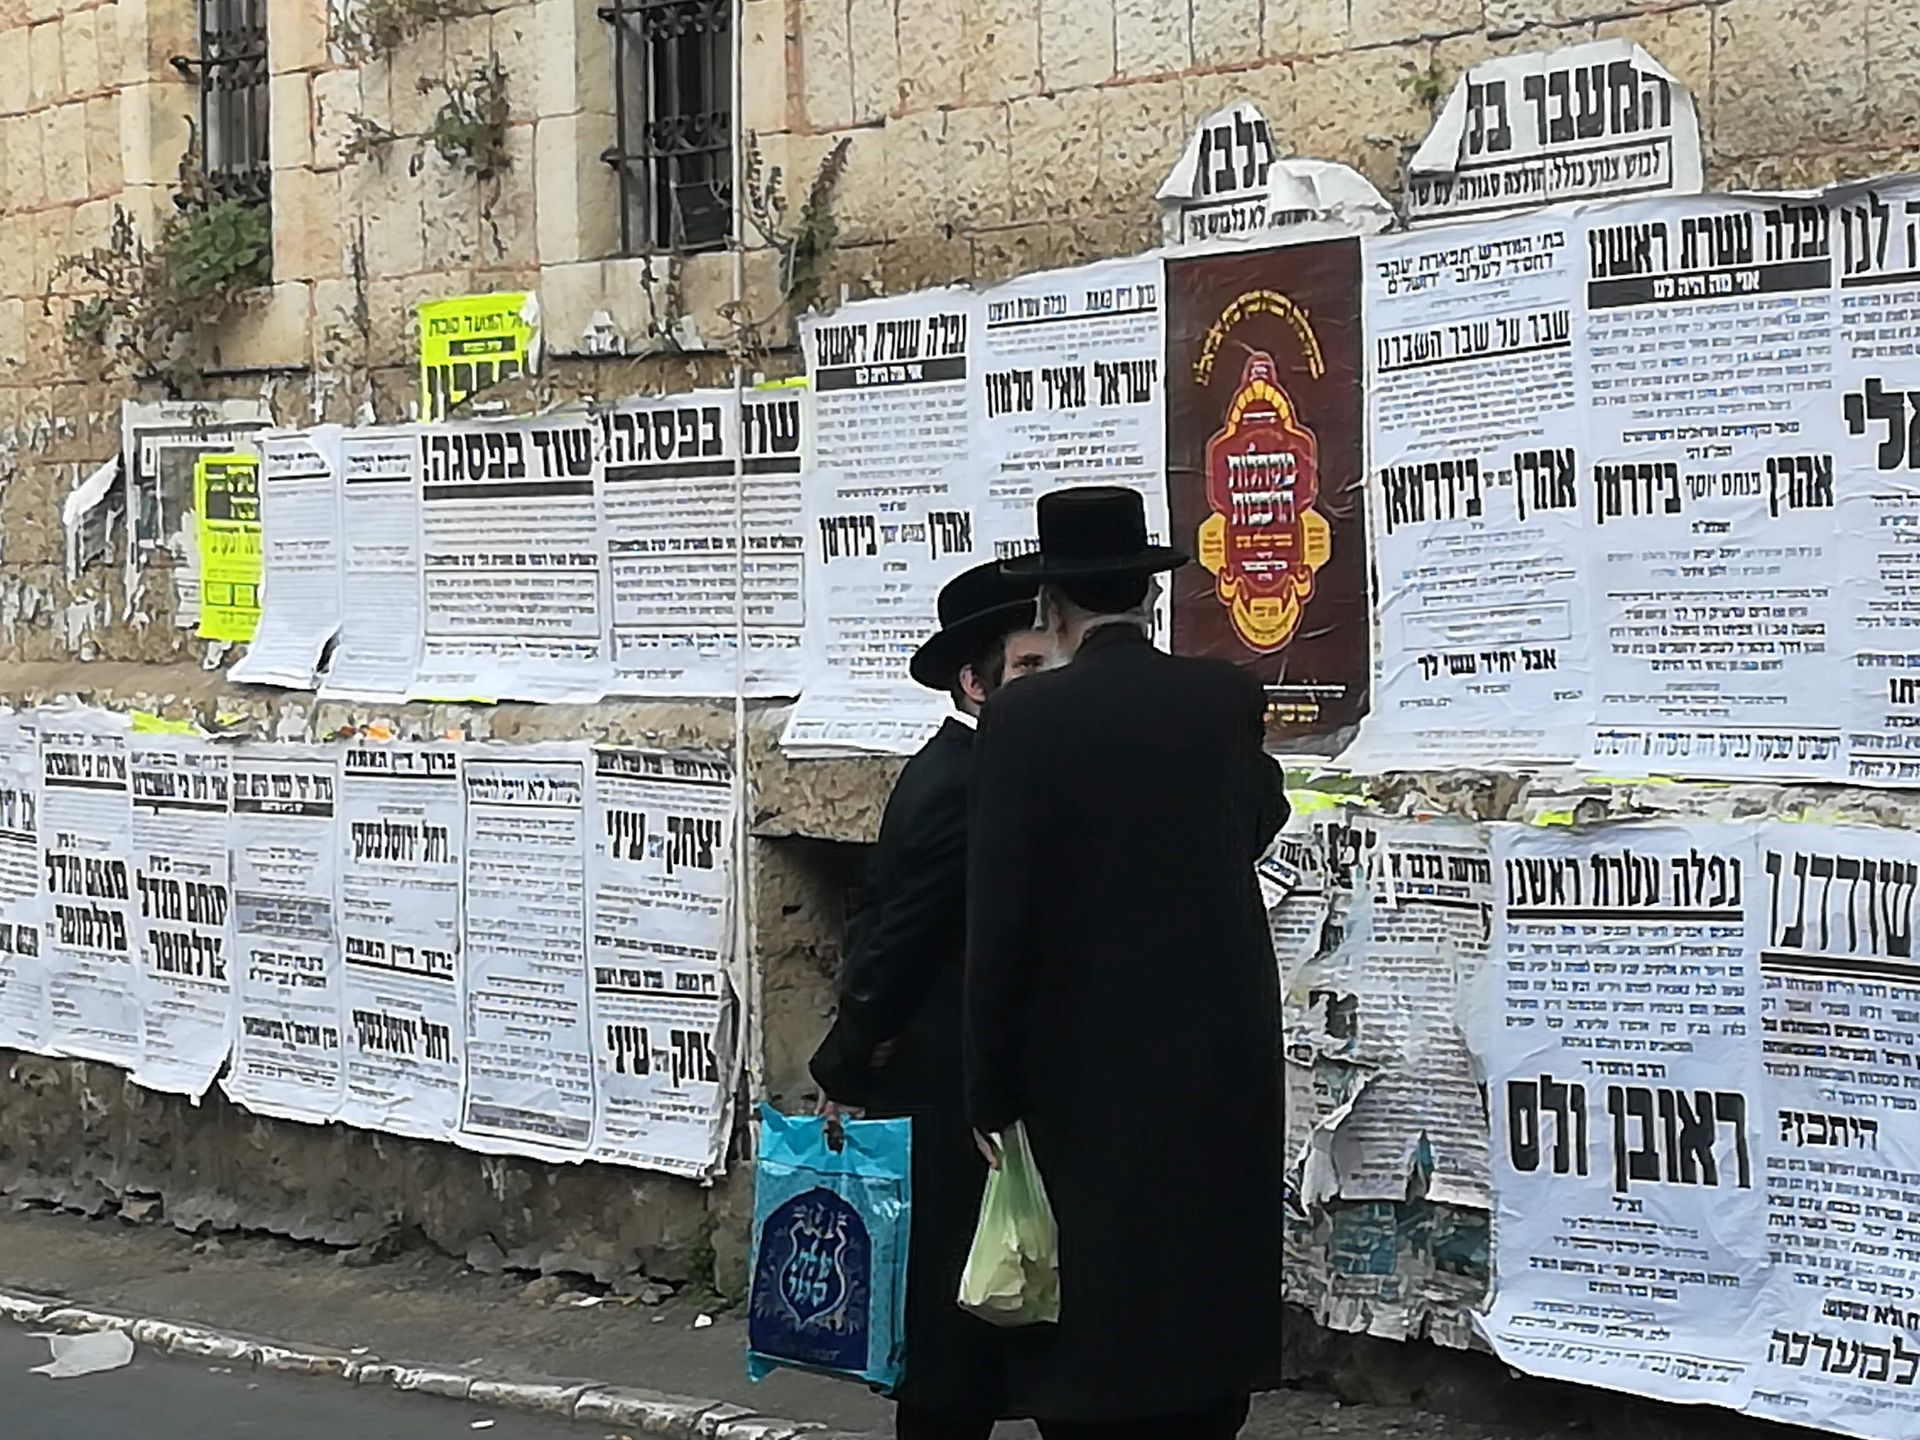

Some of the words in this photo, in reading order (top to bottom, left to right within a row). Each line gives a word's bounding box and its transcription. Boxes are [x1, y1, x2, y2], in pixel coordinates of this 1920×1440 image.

[1524, 60, 1671, 145] המעבר
[1504, 166, 1545, 195] חולצה
[1589, 156, 1620, 187] צנוע
[1626, 145, 1660, 180] לבוש
[1478, 237, 1532, 259] המדרש
[1588, 222, 1668, 278] ראשנו
[1681, 212, 1753, 269] עטרת
[1764, 203, 1830, 262] נפלה
[1841, 190, 1889, 275] לנו
[1419, 246, 1474, 271] תפארת
[873, 319, 921, 361] עטרת
[926, 313, 966, 357] נפלה
[1449, 322, 1489, 354] שבר
[1497, 316, 1520, 348] על
[1529, 310, 1570, 342] שבר
[1042, 365, 1086, 409] מאיר
[1094, 359, 1157, 406] ישראל
[421, 432, 524, 482] בפסגה!
[532, 427, 591, 478] שוד
[1381, 458, 1482, 534] בידרמאן
[1514, 448, 1576, 521] אהרן
[1594, 462, 1681, 524] בידרמן
[1766, 455, 1833, 517] אהרן
[819, 515, 877, 564] בידרמן
[928, 511, 972, 560] אהרן
[1418, 654, 1438, 680] לך
[1481, 651, 1515, 673] יחיד
[1520, 647, 1557, 670] אבל
[346, 750, 387, 768] האמת
[420, 752, 456, 773] ברוך
[422, 819, 447, 863] רחל
[667, 816, 721, 874] יצחק
[1506, 857, 1581, 906] ראשנו
[1591, 849, 1659, 906] עטרת
[1671, 849, 1741, 907] נפלה
[420, 1016, 450, 1063] רחל
[671, 1030, 719, 1088] צחק
[1507, 1074, 1588, 1176] ולס
[1608, 1086, 1751, 1193] ראובן
[1767, 1330, 1919, 1385] למערכה
